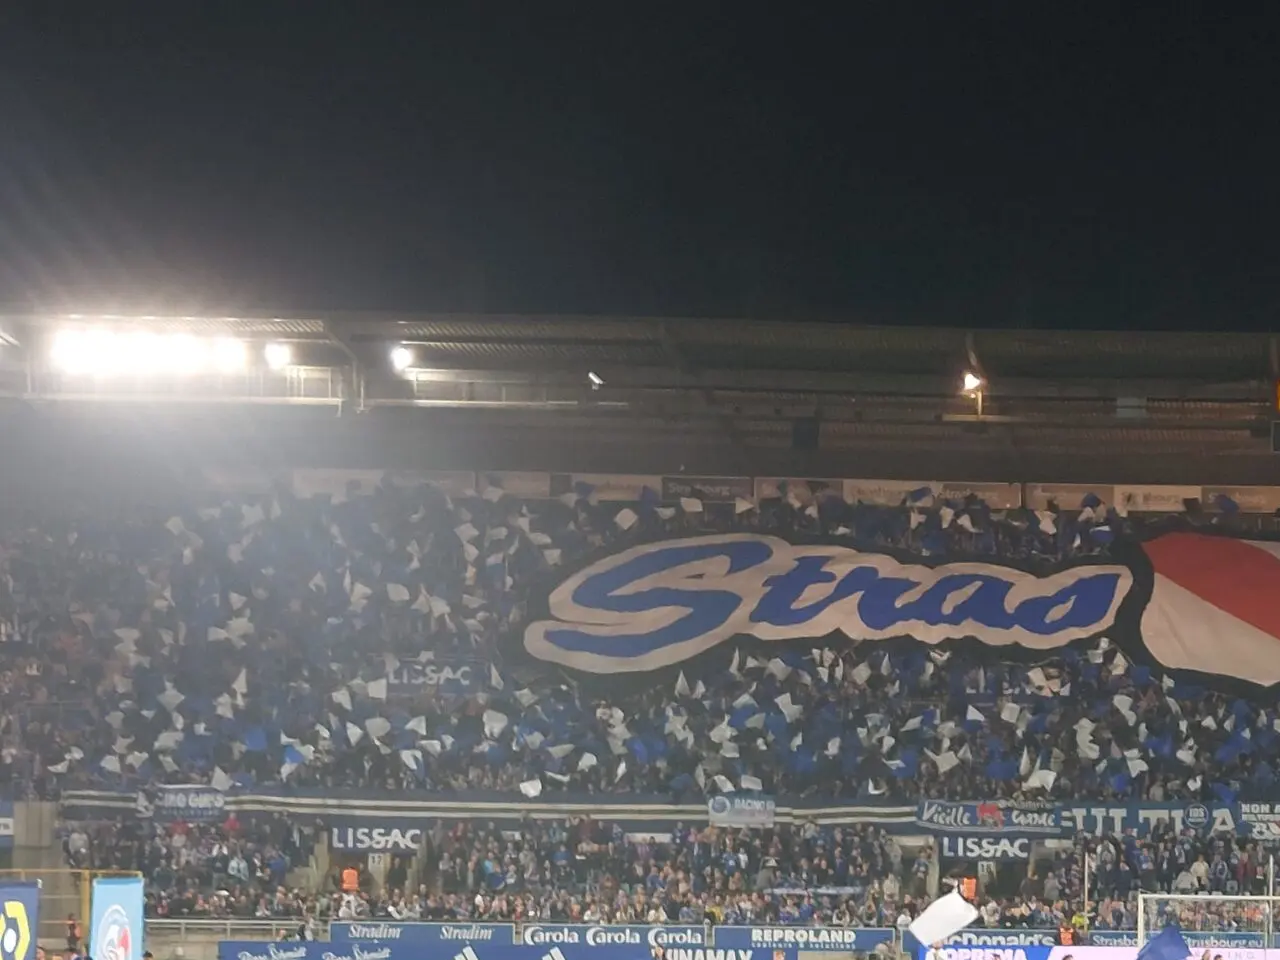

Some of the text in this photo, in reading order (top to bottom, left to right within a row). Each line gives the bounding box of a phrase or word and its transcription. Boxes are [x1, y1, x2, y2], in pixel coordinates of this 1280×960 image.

[332, 827, 421, 849] LISSAC
[942, 837, 1029, 858] LISSAC
[348, 923, 402, 939] Stradim
[440, 925, 493, 940] Stradim
[524, 927, 579, 944] Carola
[586, 927, 641, 945] Carola
[648, 928, 702, 945] Carola
[752, 928, 856, 943] REPROLAND
[944, 932, 1056, 945] cDonald's
